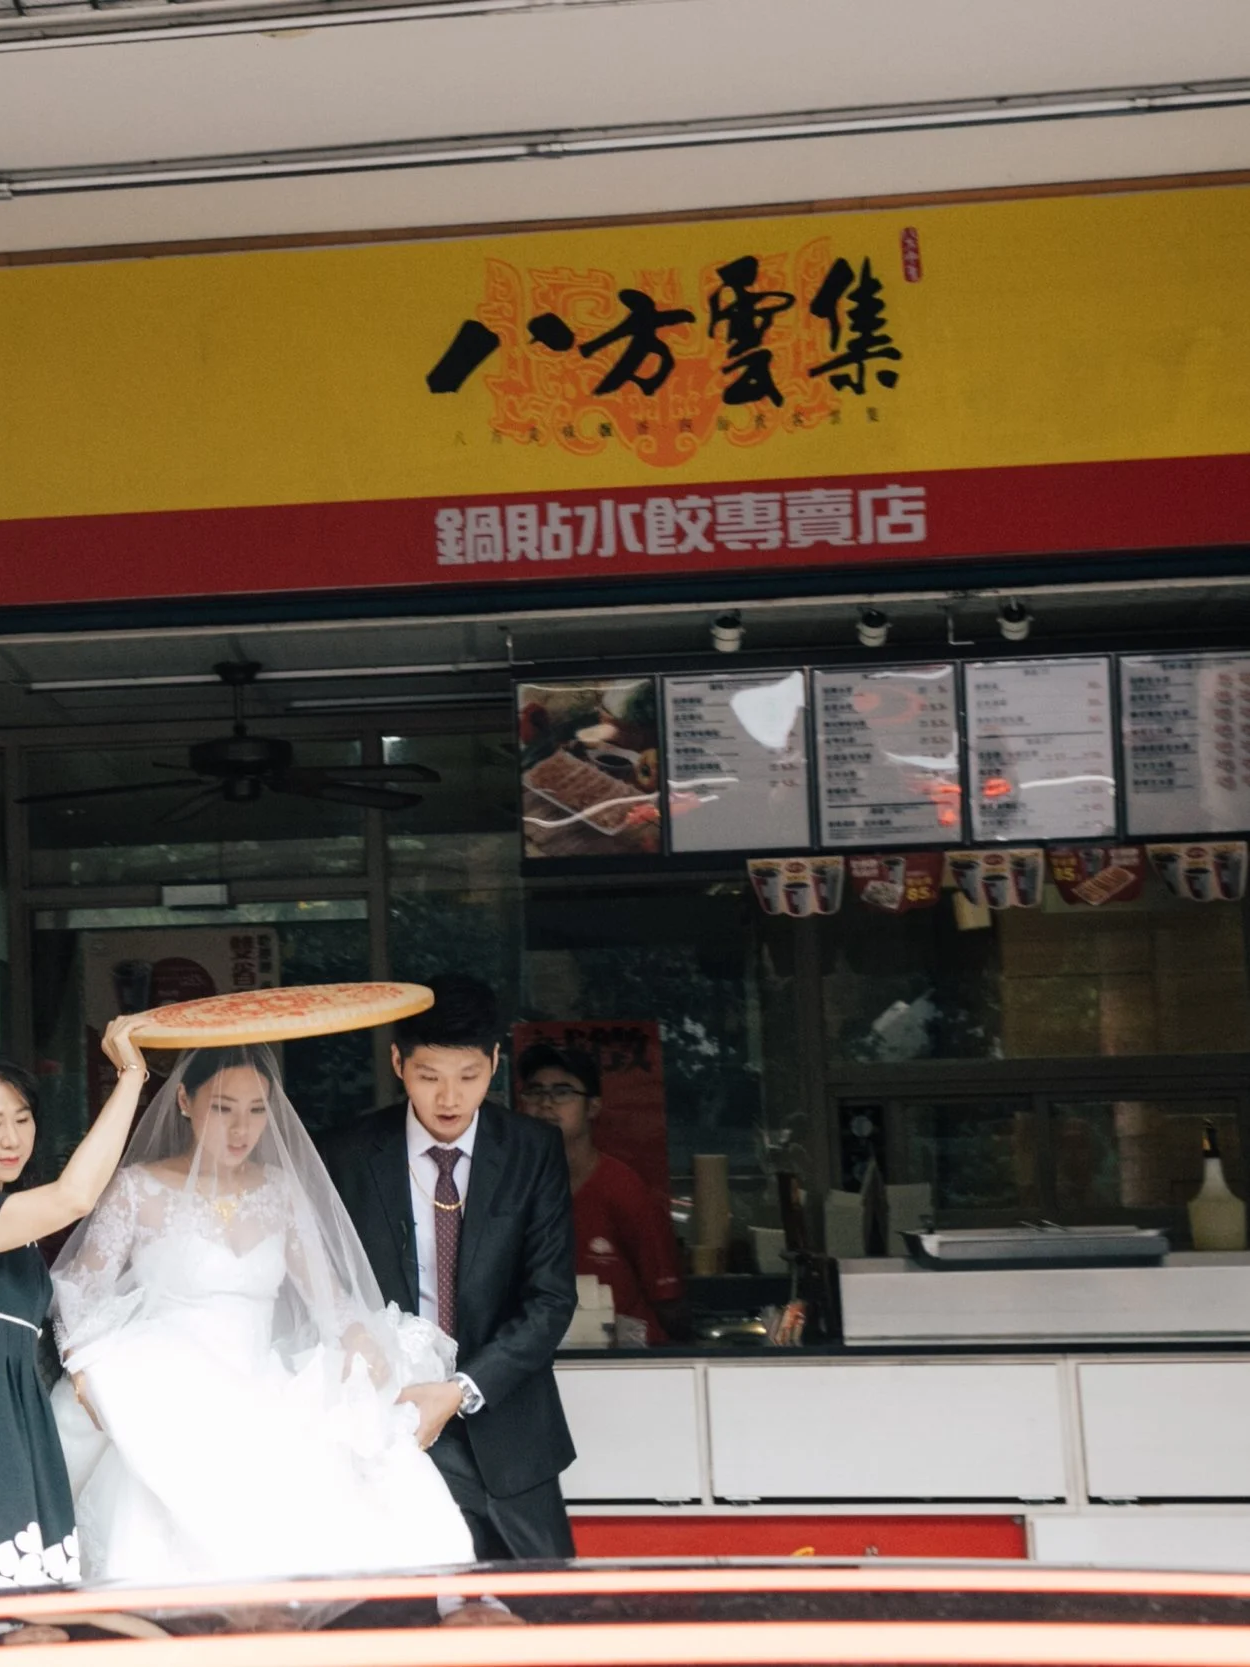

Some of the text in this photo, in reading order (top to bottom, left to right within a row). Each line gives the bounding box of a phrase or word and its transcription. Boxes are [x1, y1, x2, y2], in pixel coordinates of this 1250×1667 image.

[426, 255, 903, 407] 八方雲集
[434, 485, 927, 566] 鍋貼水餃專賣店
